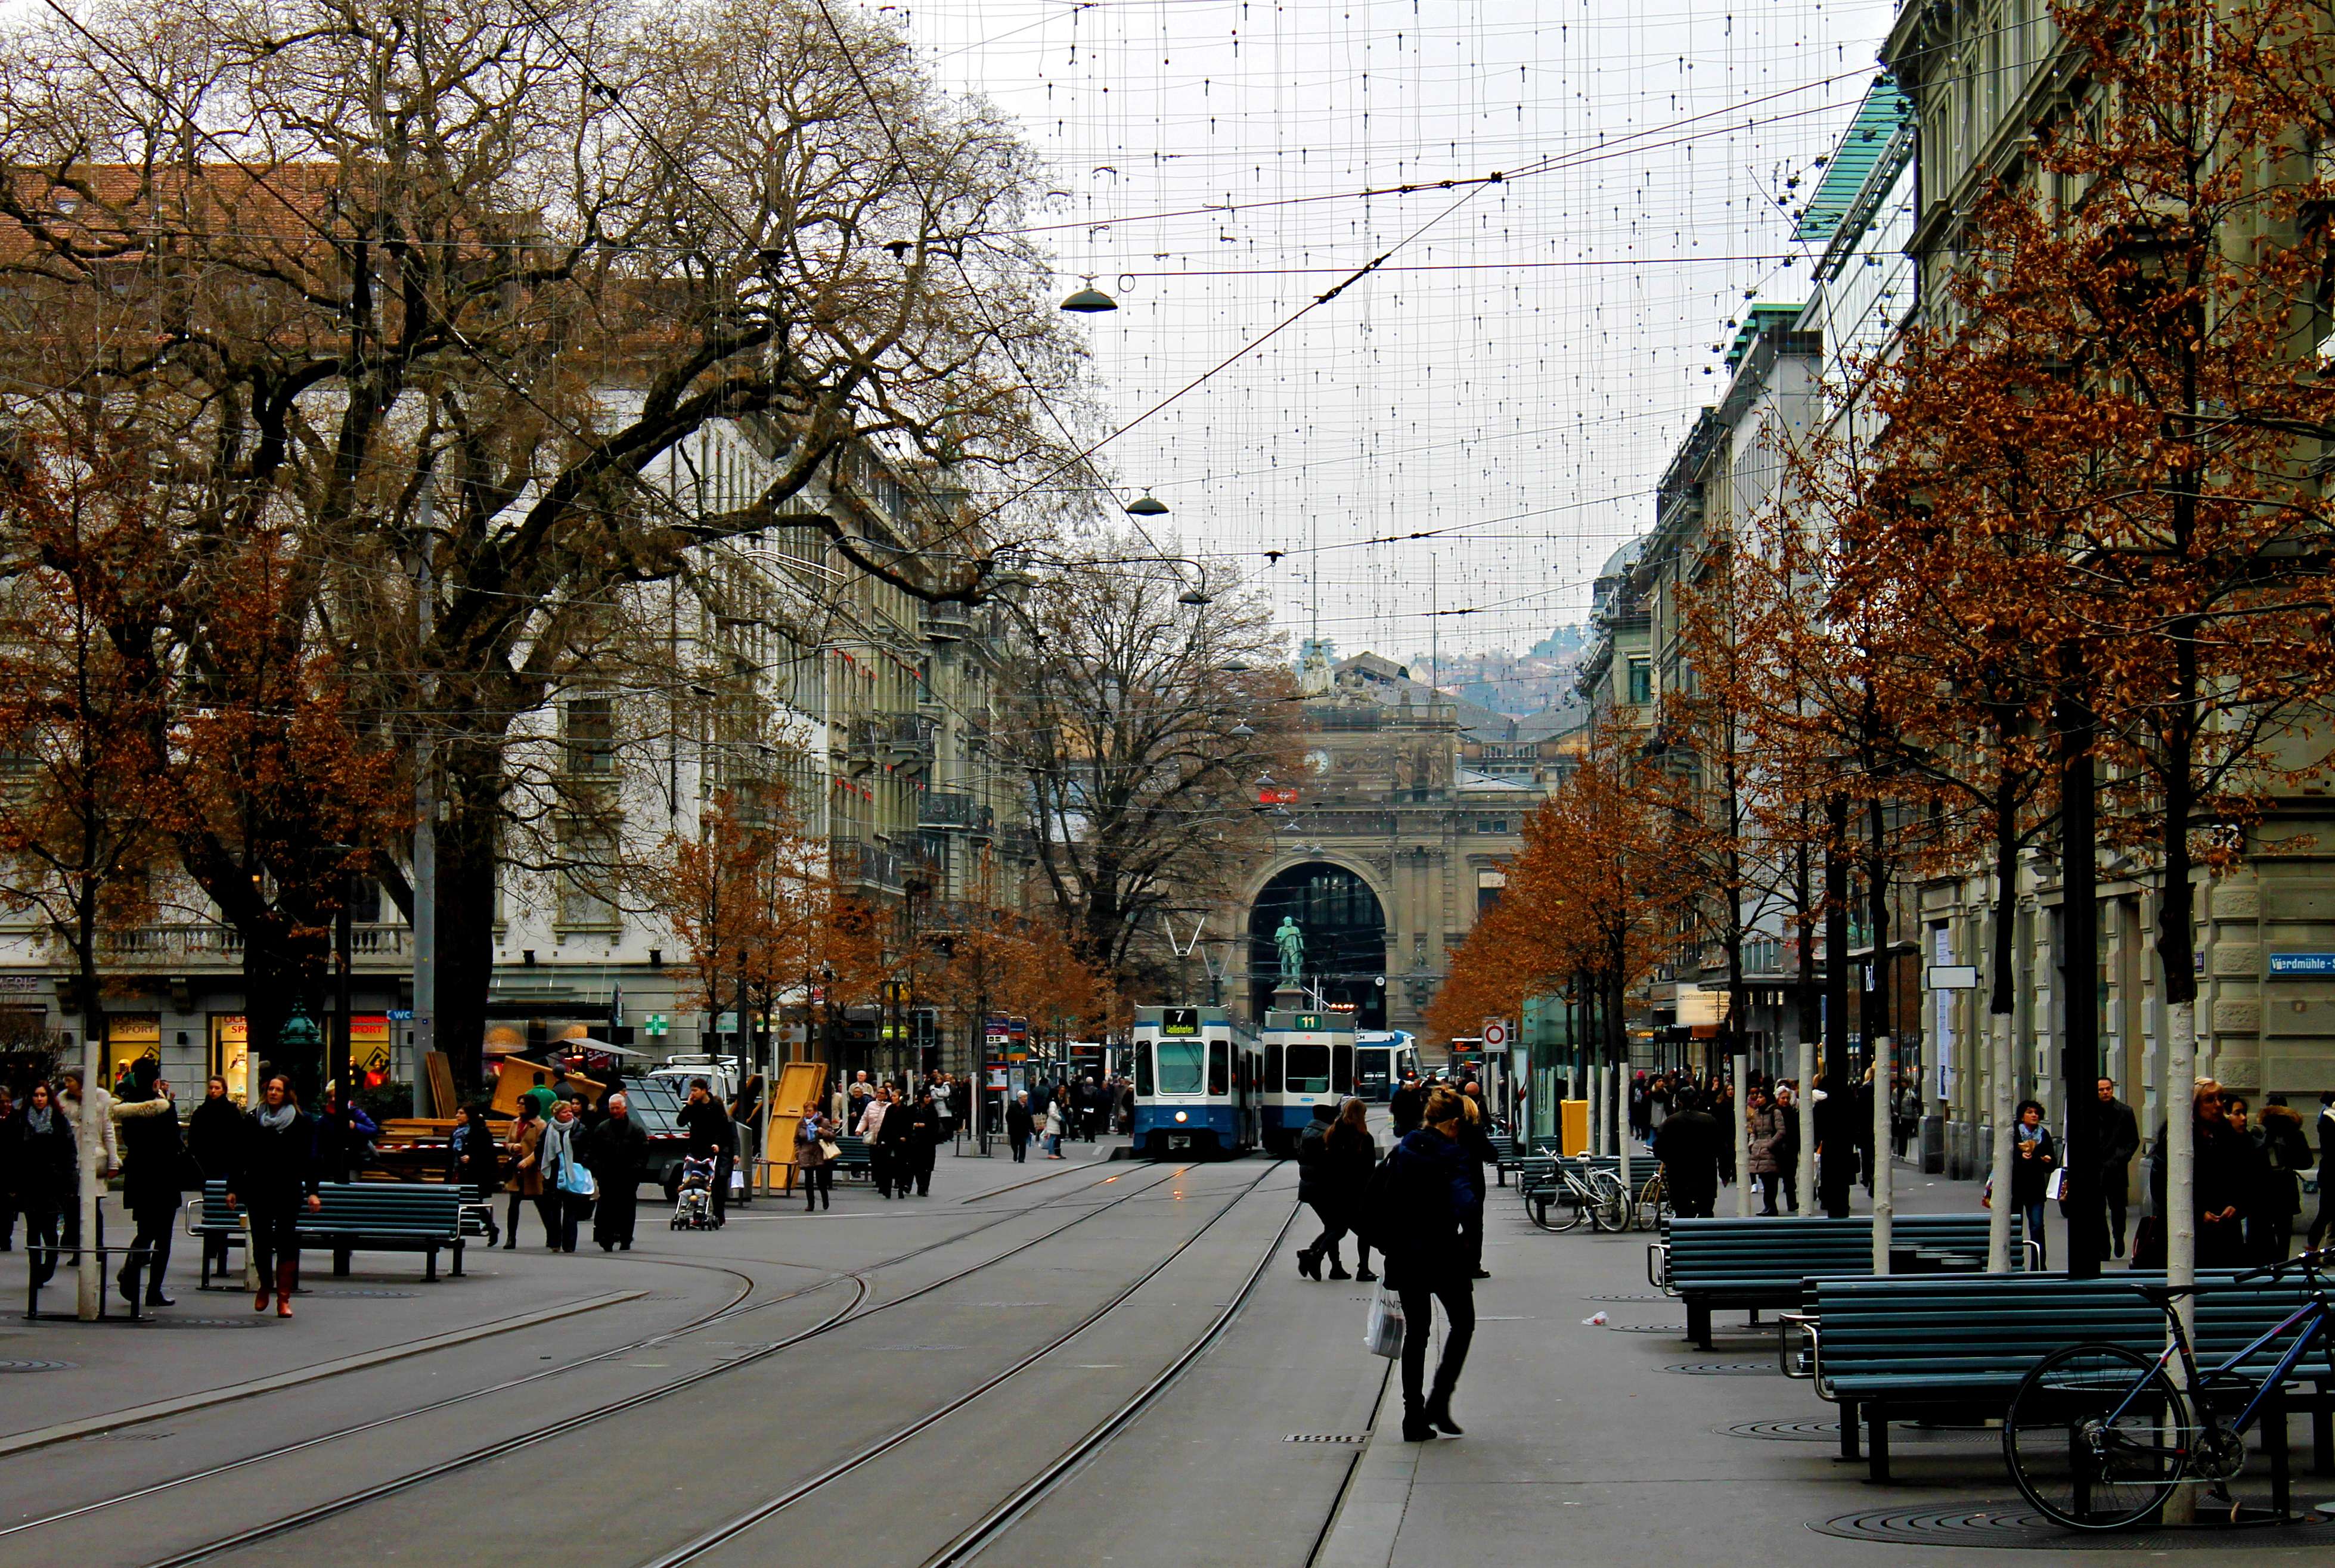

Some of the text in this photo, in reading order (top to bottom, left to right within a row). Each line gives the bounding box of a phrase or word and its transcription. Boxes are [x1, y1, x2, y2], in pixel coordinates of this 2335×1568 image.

[393, 1011, 410, 1019] WC
[1176, 1010, 1184, 1022] 7
[1301, 1016, 1314, 1027] 11
[119, 1025, 154, 1033] SPORT
